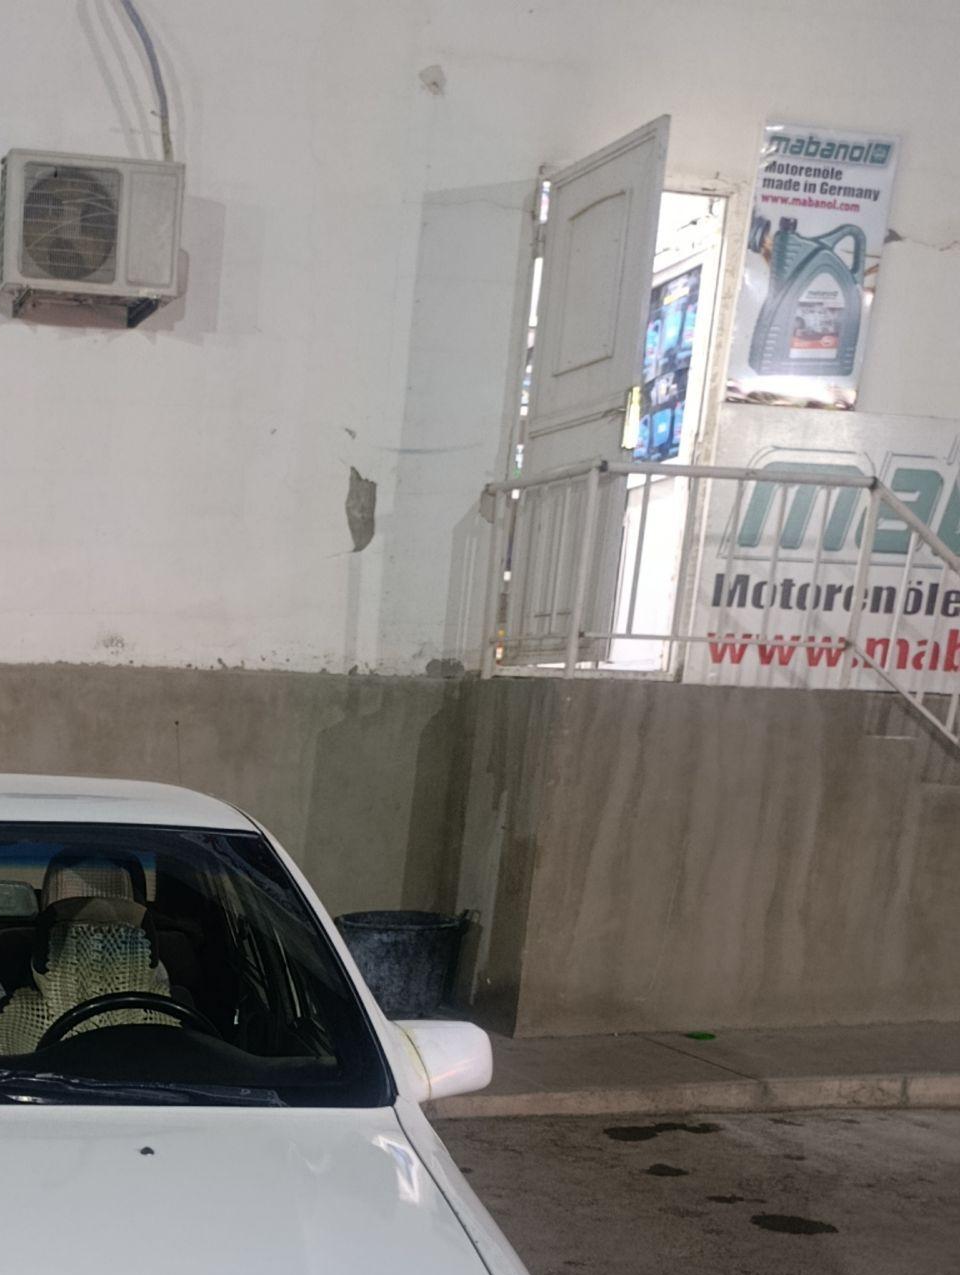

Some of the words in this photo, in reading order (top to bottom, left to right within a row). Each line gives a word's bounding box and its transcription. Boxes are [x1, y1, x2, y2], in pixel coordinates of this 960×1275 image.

[762, 177, 801, 193] made
[803, 179, 818, 194] in
[819, 182, 881, 202] Germany
[761, 194, 860, 212] www.mabanol.com
[710, 573, 960, 618] Motorenöle
